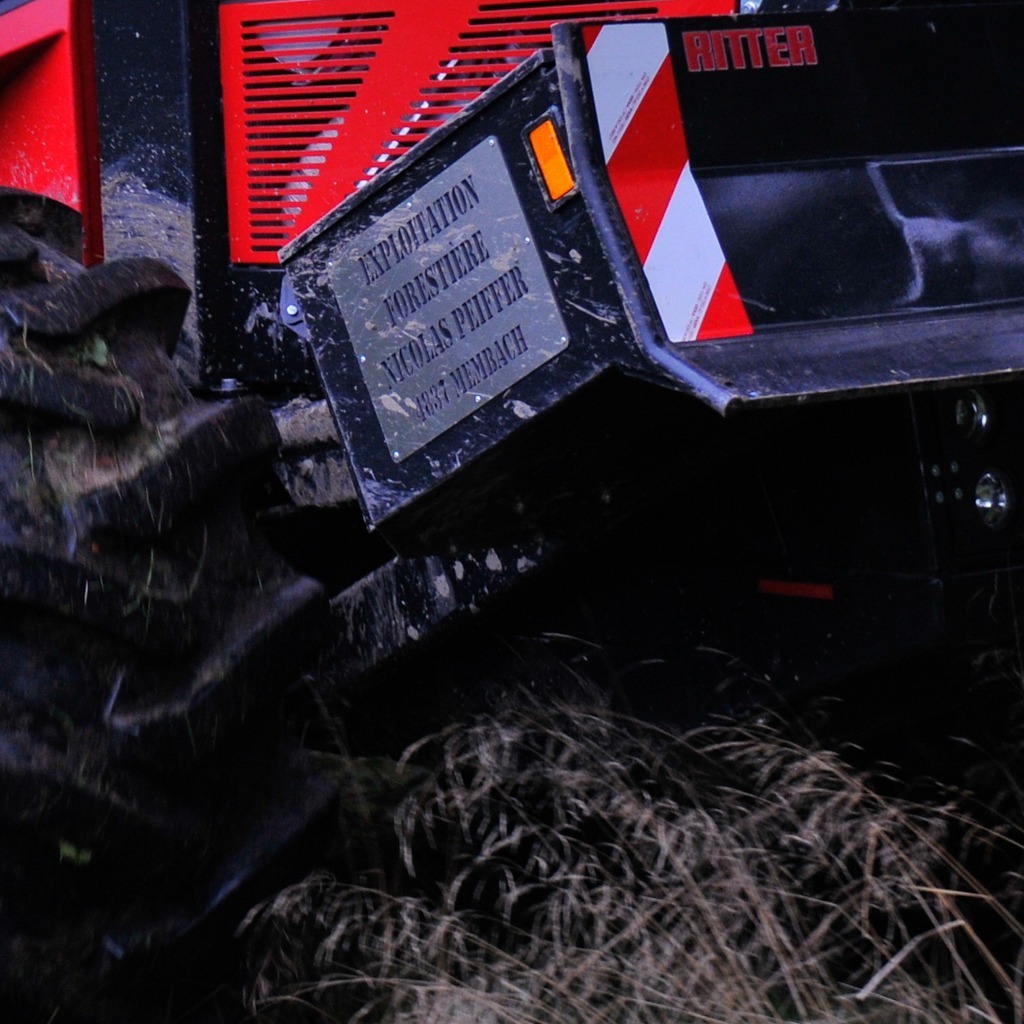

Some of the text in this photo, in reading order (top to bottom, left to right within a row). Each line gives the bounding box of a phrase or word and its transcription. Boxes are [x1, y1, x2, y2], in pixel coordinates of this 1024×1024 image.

[681, 25, 819, 73] RITTER
[357, 175, 481, 286] EXPLOITATION
[382, 229, 491, 328] FORESTIÈRE
[379, 265, 529, 390] NICOLAS PEIFFER
[448, 324, 530, 398] MEMBACH
